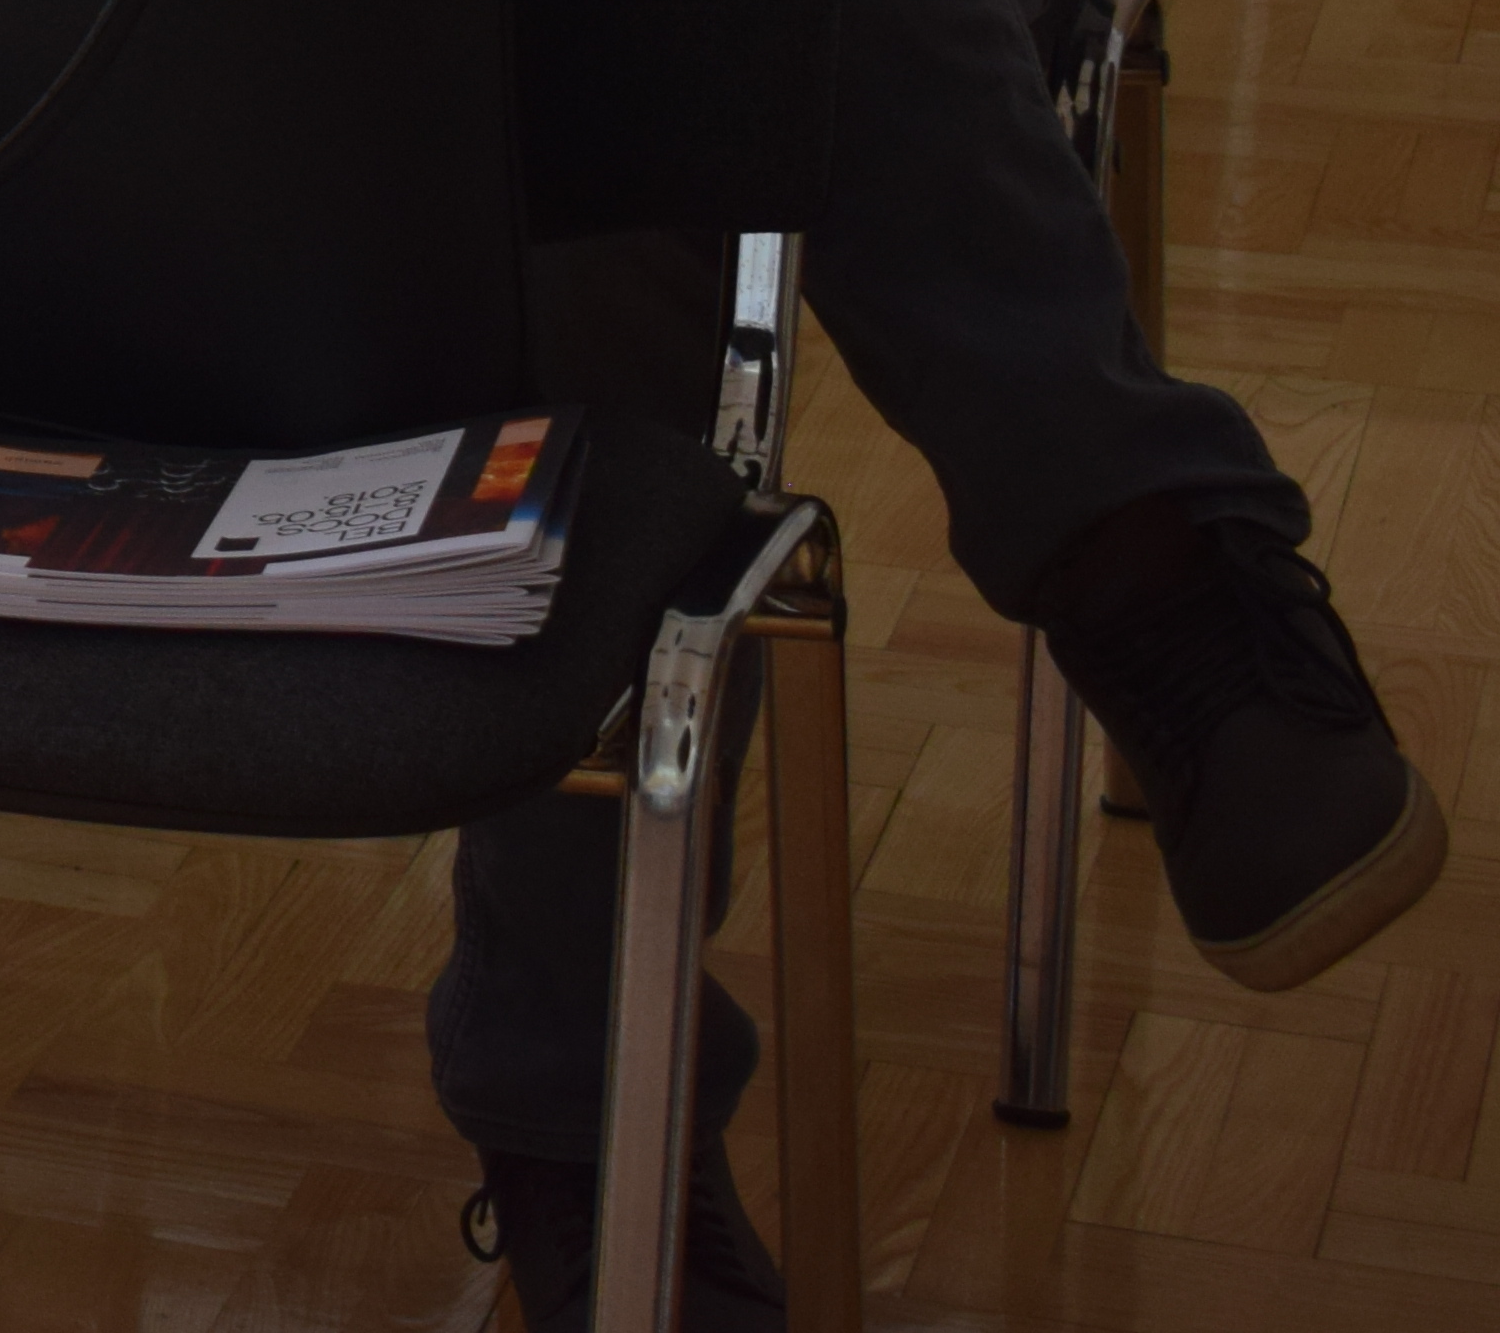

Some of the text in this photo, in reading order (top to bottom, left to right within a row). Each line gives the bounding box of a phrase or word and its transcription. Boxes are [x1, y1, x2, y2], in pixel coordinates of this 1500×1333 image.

[323, 480, 427, 506] 2019.
[276, 507, 413, 537] DOCS
[325, 521, 406, 541] BEL
